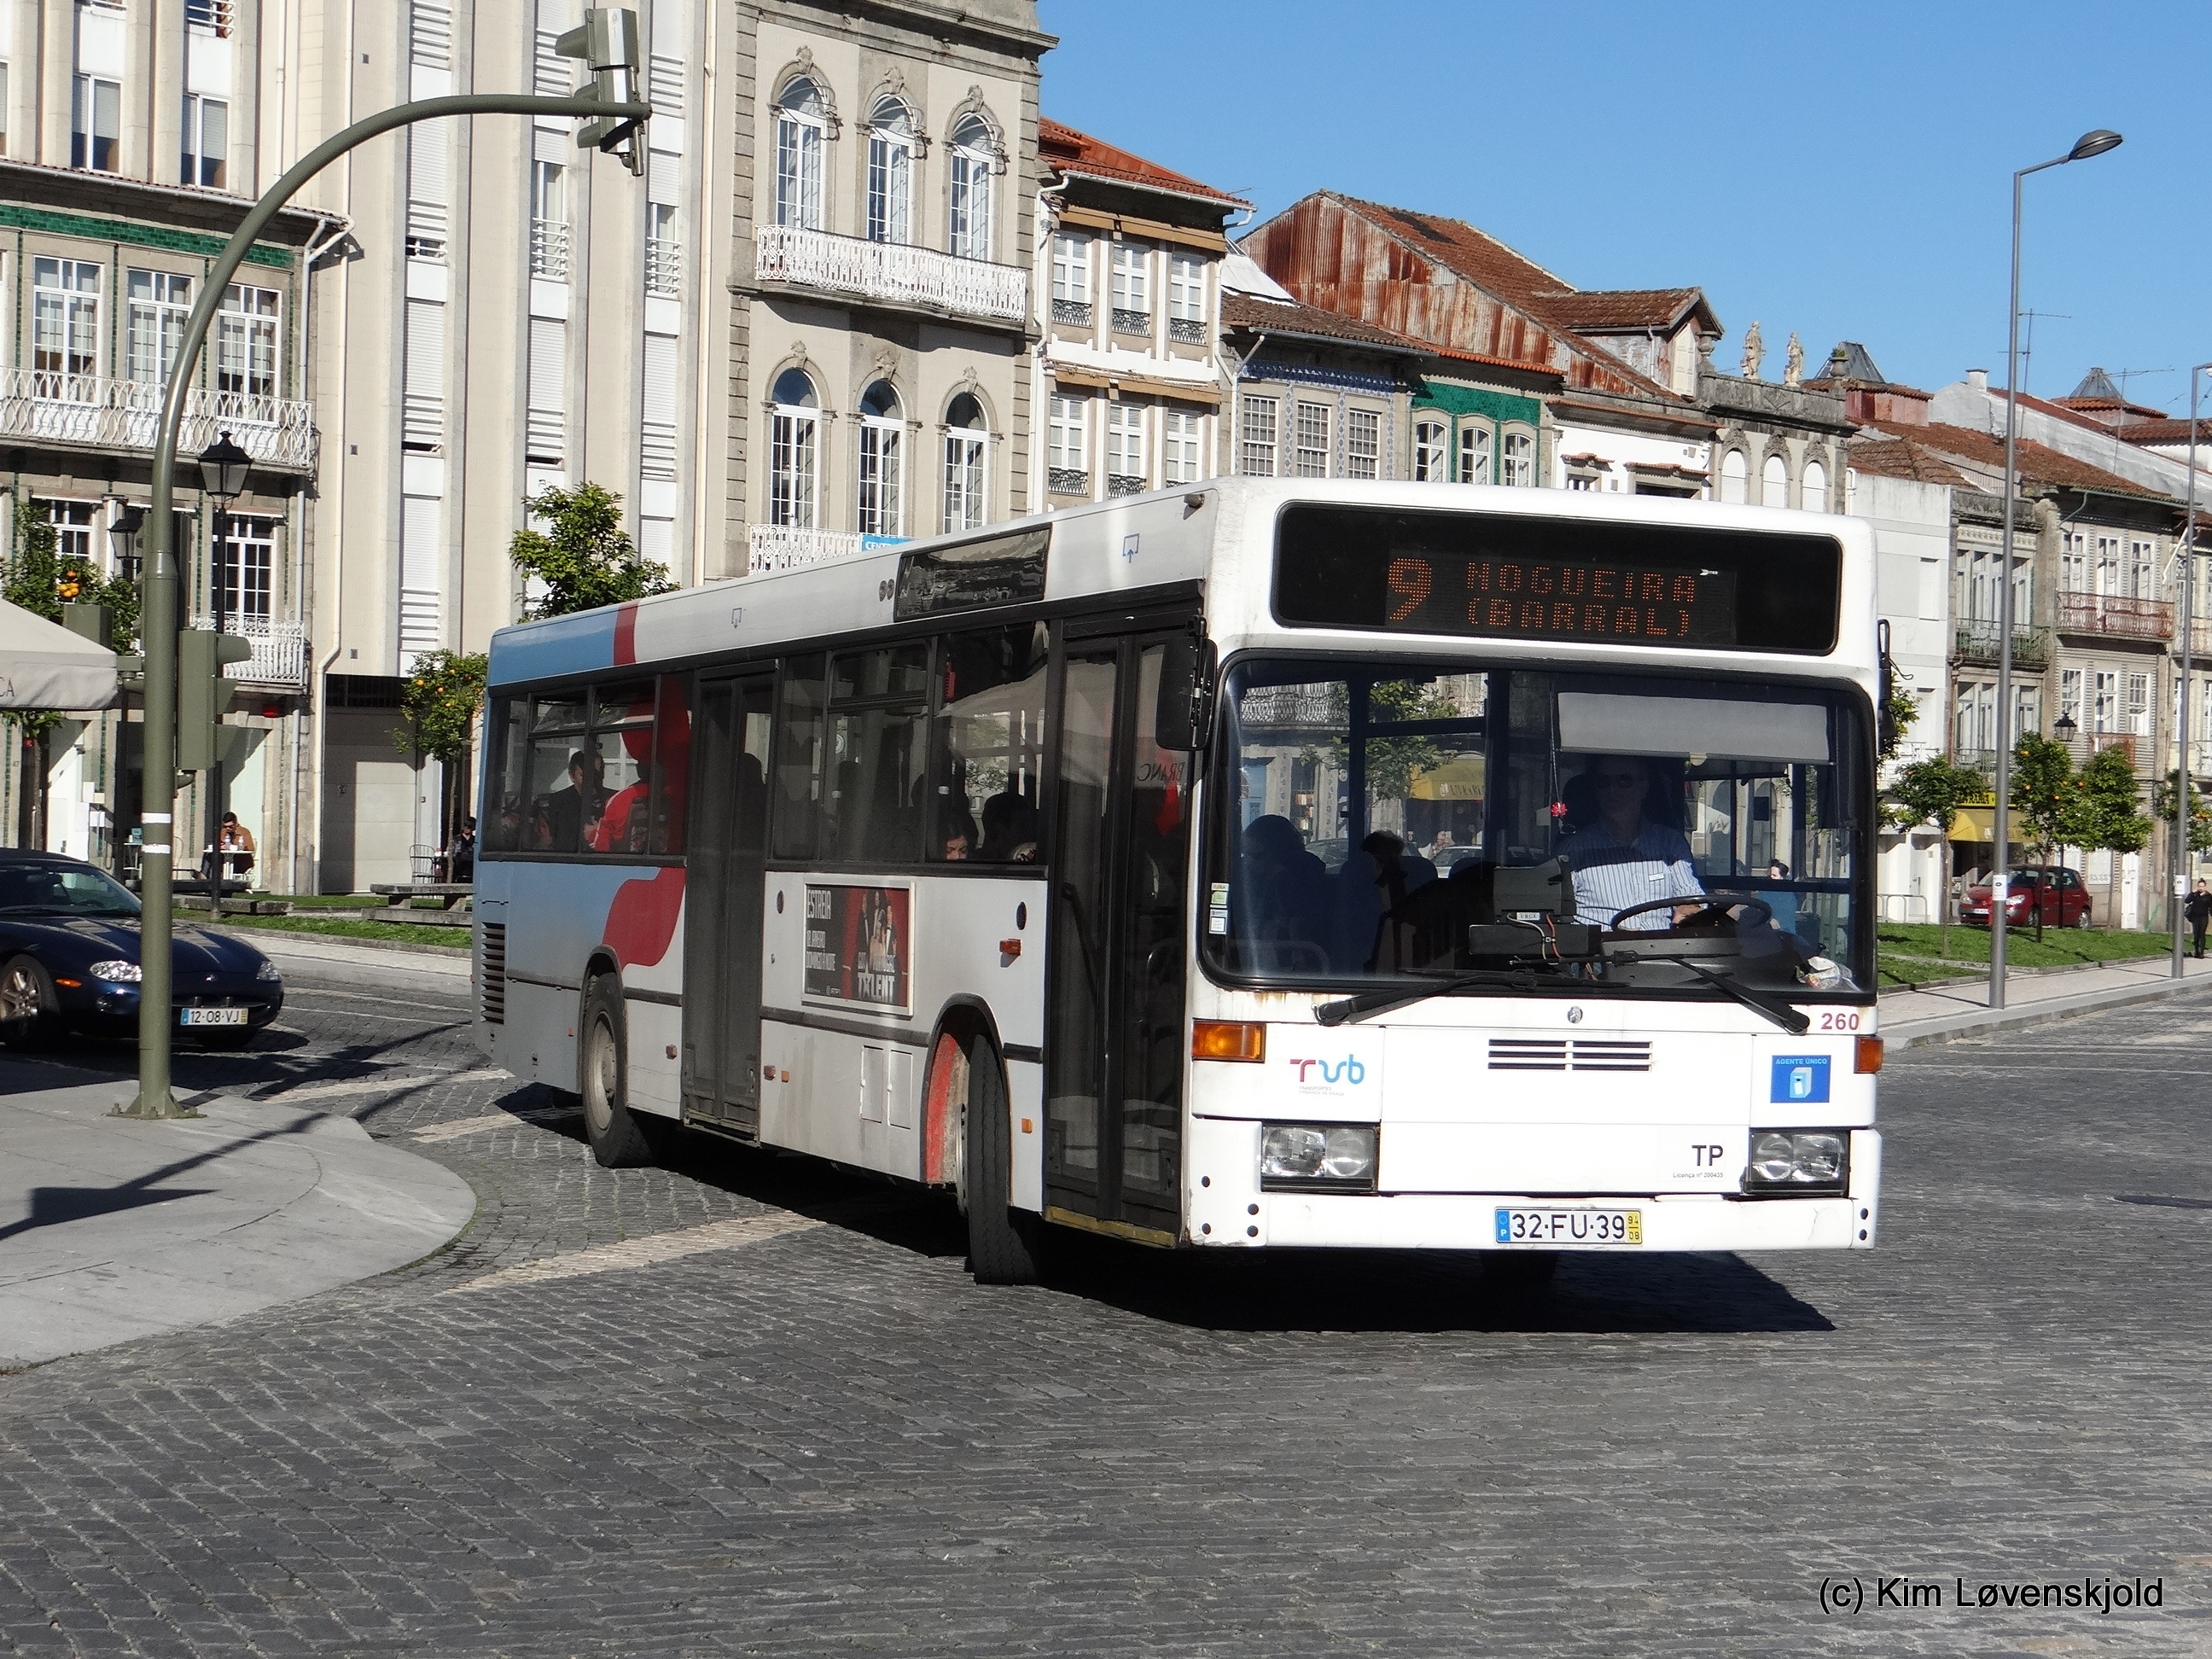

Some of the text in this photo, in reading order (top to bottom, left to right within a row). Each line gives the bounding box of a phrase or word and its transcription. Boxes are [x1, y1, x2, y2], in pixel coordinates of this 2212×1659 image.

[1388, 557, 1432, 622] 9
[1466, 562, 1696, 602] NOGUEIRA
[1468, 597, 1690, 637] (BARRAL)
[806, 889, 831, 919] ESTREIA
[1820, 1012, 1860, 1031] 260
[1805, 1057, 1828, 1065] ÚNICO
[1691, 1144, 1724, 1167] TP
[1627, 1215, 1639, 1225] 94
[1500, 1229, 1507, 1237] P
